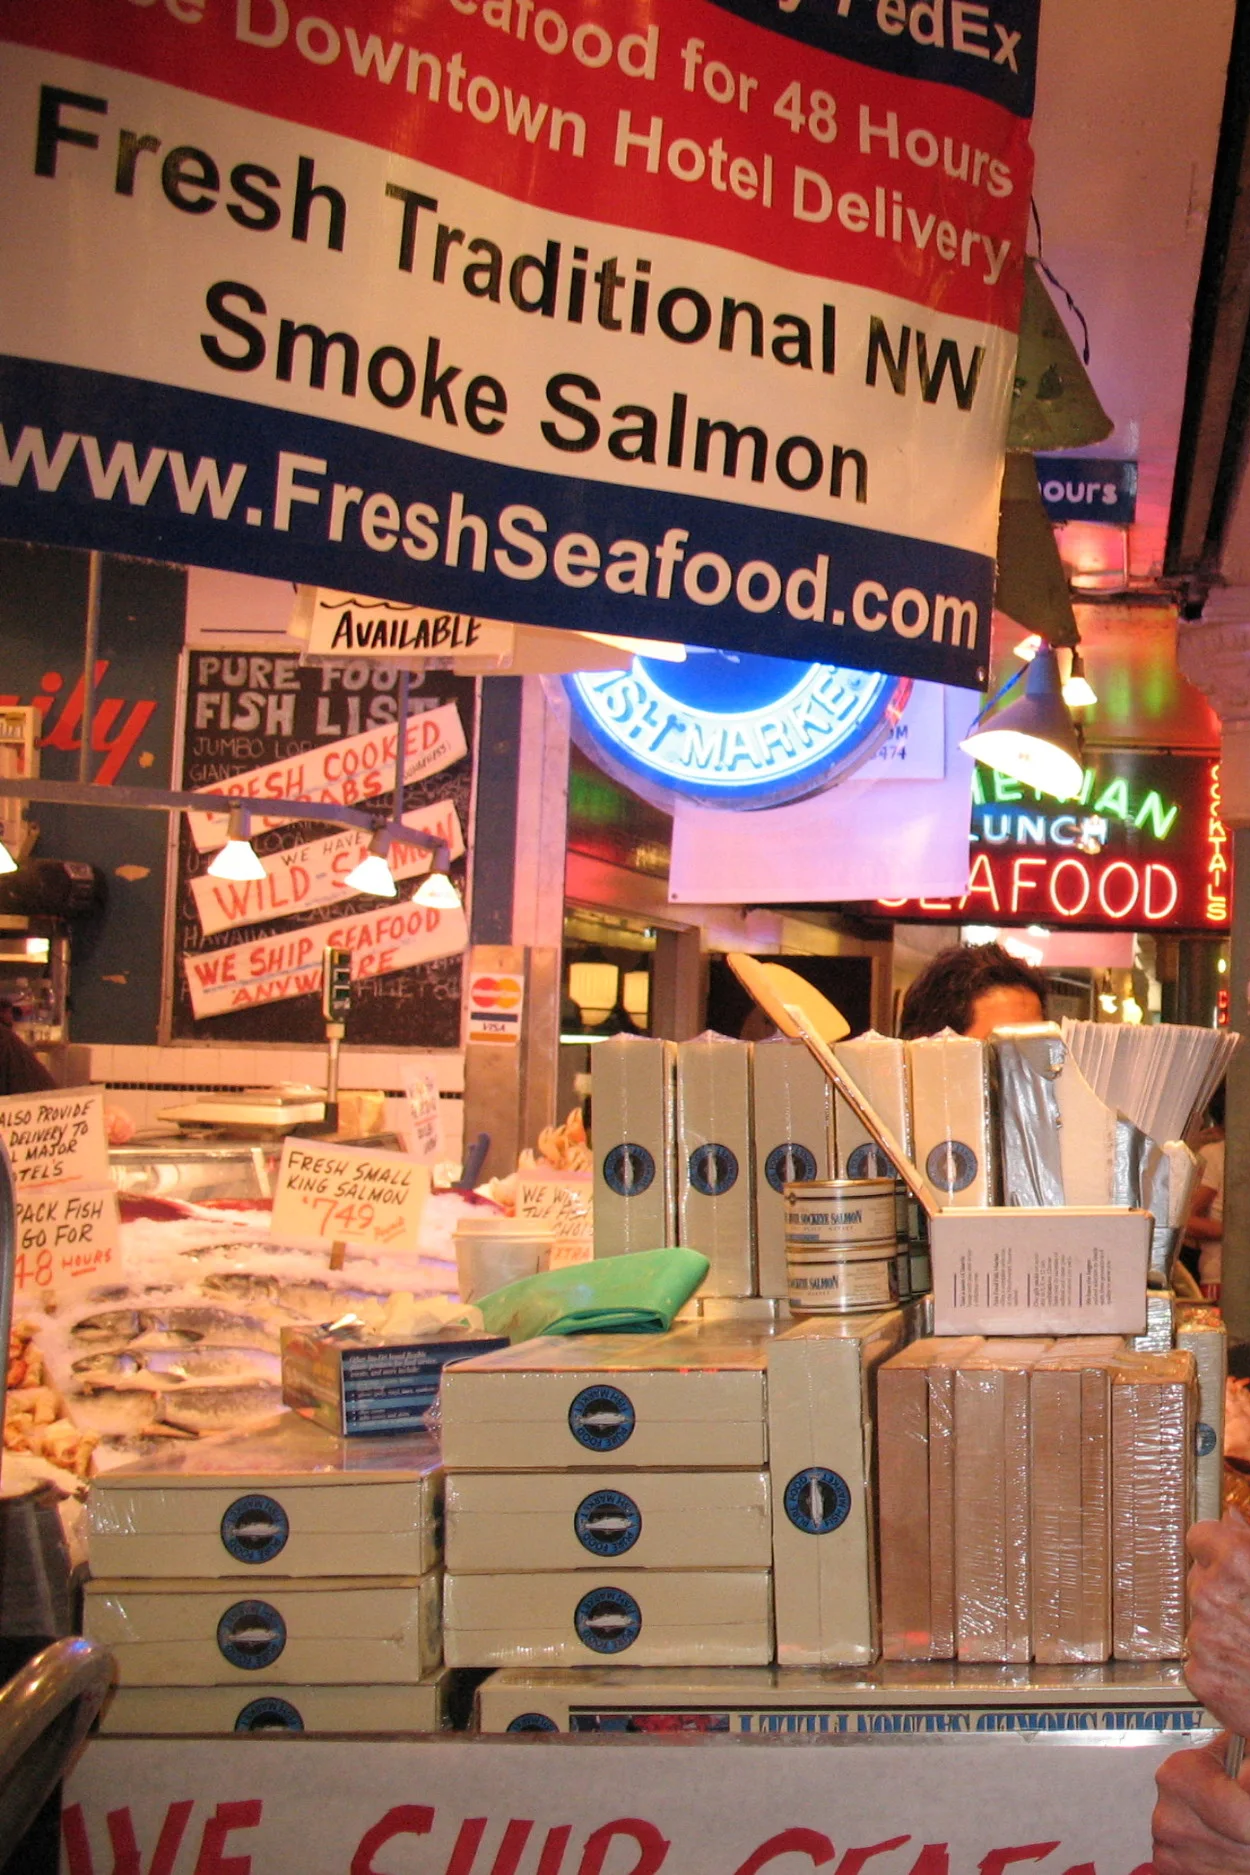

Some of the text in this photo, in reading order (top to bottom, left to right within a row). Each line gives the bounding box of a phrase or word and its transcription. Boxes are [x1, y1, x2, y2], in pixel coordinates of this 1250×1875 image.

[682, 40, 758, 114] for
[774, 88, 838, 144] 48
[859, 105, 1015, 198] Hours
[235, 0, 1011, 285] Downtown Hotel Delivery
[34, 83, 986, 411] Fresh Traditional NW
[200, 280, 868, 504] Smoke Salmon
[1038, 480, 1118, 506] ours
[0, 421, 979, 650] www.FreshSeafood.com
[331, 610, 481, 650] AVAILABLE
[198, 656, 427, 693] PURE FOOD
[194, 691, 297, 737] FISH
[191, 736, 264, 758] JUMBO
[324, 721, 441, 781] COOKED
[969, 816, 1108, 845] UNCH
[280, 833, 366, 867] WE HAVE
[213, 866, 311, 921] WILD
[194, 954, 237, 986] WE
[250, 937, 314, 977] SHIP
[327, 907, 442, 950] SEAFOOD
[232, 948, 399, 1006] ANYWRE
[0, 1100, 95, 1127] ALSO PROVIDE
[9, 1121, 89, 1148] DELIVERY TO
[26, 1140, 78, 1161] MAJOR
[287, 1150, 412, 1187] FRESH SMALL
[286, 1173, 410, 1206] KING SALMON
[522, 1183, 548, 1204] WE
[16, 1197, 103, 1226] PACK FISH
[830, 1209, 863, 1226] SALMON
[21, 1223, 94, 1250] GO FOR
[61, 1247, 112, 1270] HOURS
[576, 1426, 629, 1448] PURE FOOD
[786, 1475, 810, 1527] PURE FOOD
